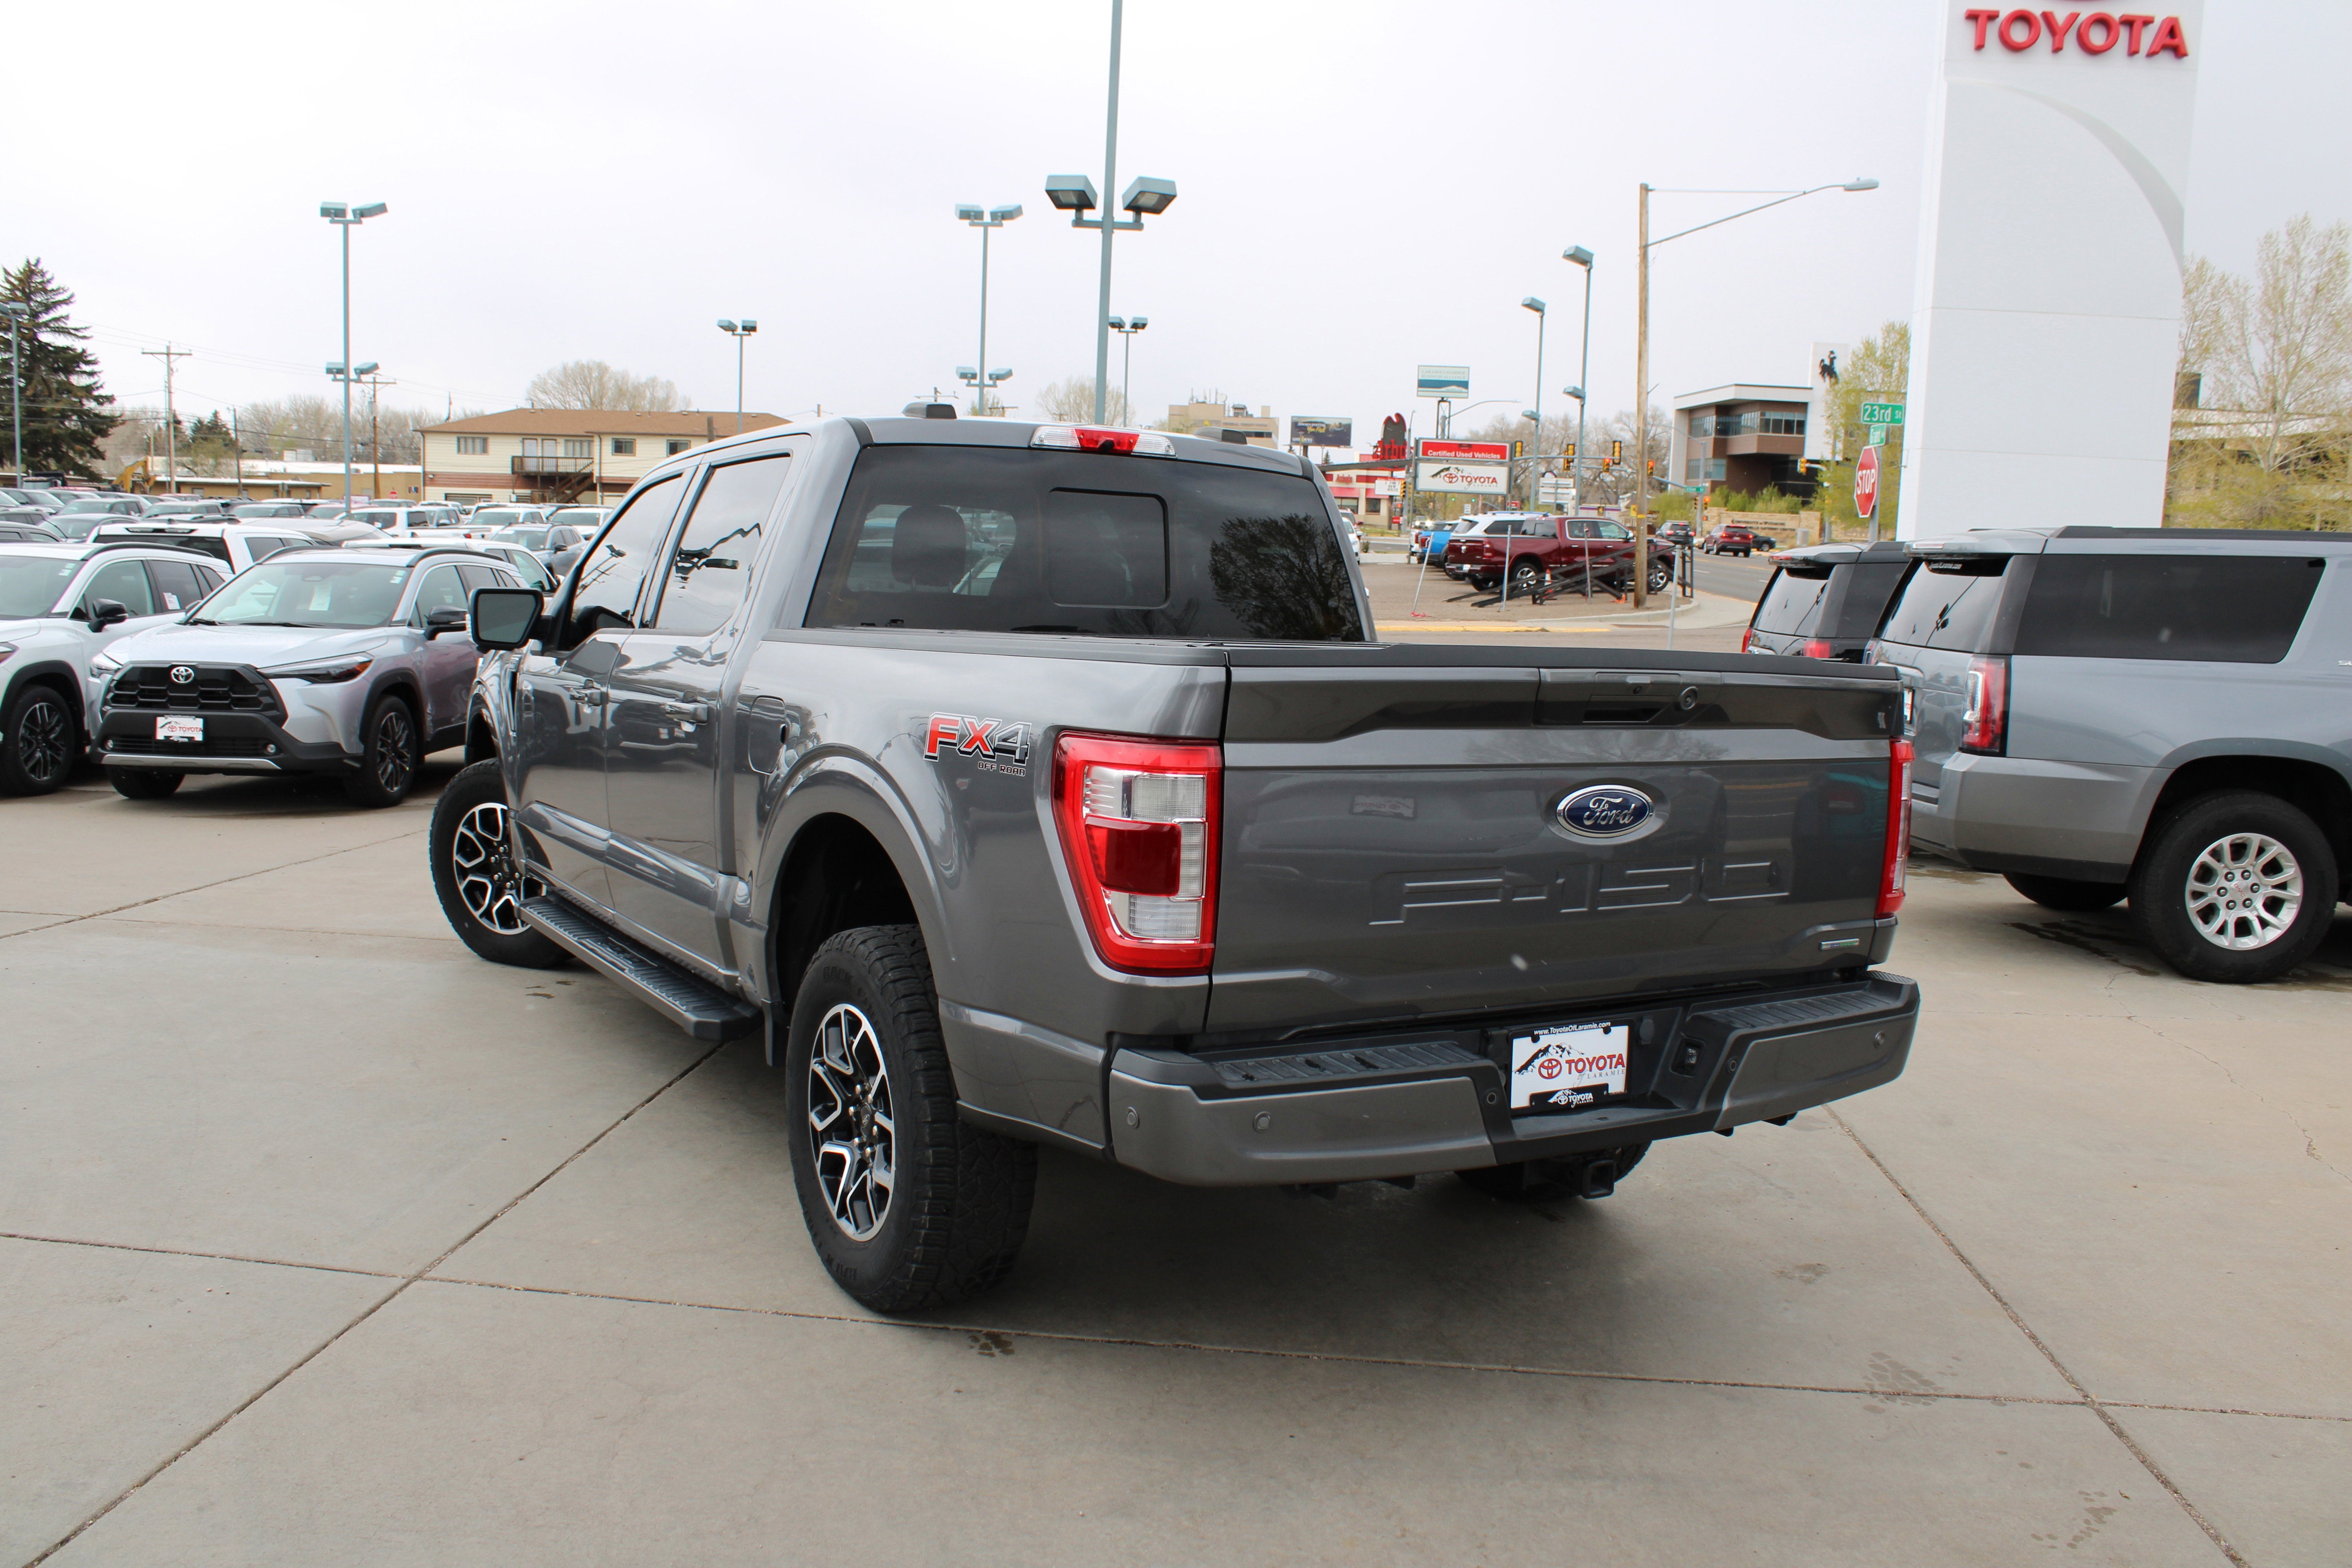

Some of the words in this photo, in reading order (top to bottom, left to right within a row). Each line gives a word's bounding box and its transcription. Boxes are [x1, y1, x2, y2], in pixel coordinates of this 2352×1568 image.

[1964, 9, 2189, 57] TOYOTA
[1863, 405, 1892, 422] 23rd
[1895, 410, 1902, 419] St
[1459, 475, 1498, 484] TOYOTA
[1857, 468, 1875, 495] STOP
[923, 712, 1032, 766] FX4
[978, 761, 997, 771] OFF
[999, 764, 1026, 777] ROAD
[1583, 796, 1636, 825] Ford
[1369, 851, 1794, 925] F-150
[2234, 883, 2245, 898] GMC
[1534, 1022, 1611, 1035] www.ToyotaOfLaramie.com
[1565, 1053, 1626, 1075] TOYOTA
[1587, 1068, 1626, 1079] LARAMIE
[1568, 1092, 1593, 1102] TOYOTA
